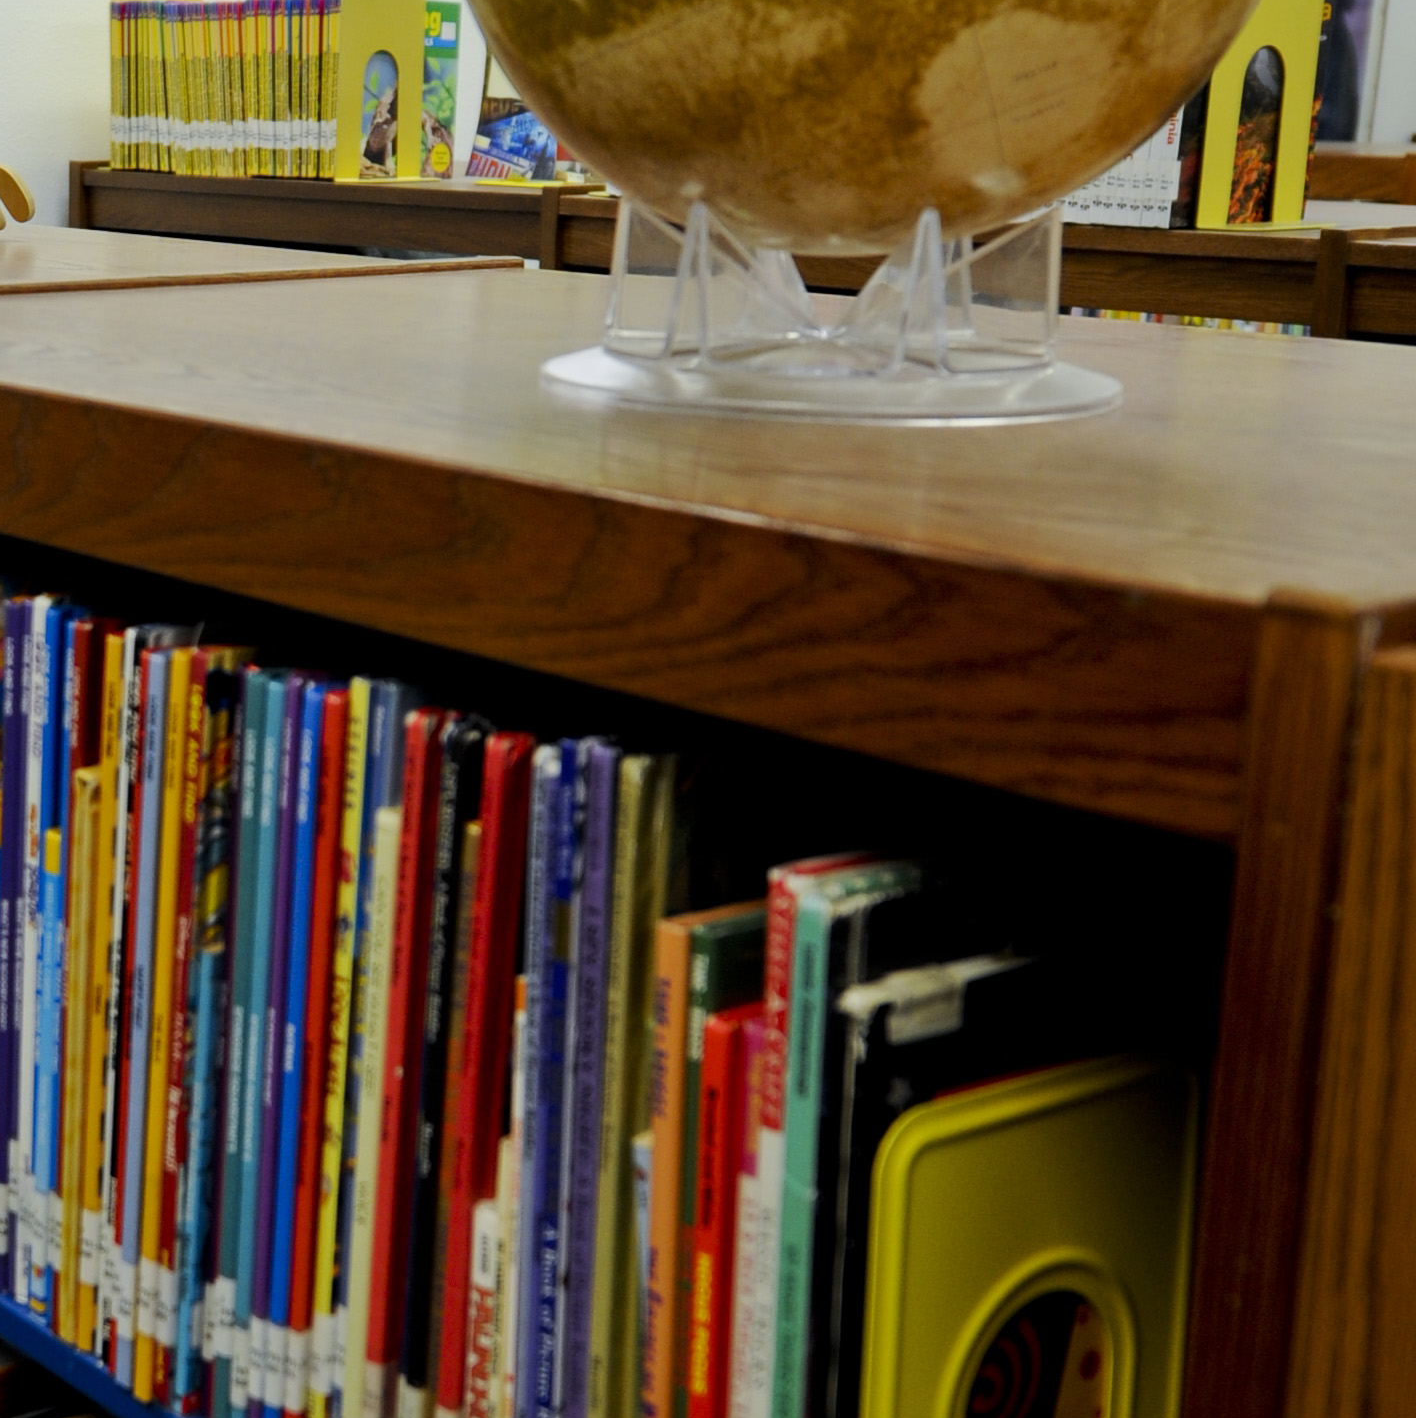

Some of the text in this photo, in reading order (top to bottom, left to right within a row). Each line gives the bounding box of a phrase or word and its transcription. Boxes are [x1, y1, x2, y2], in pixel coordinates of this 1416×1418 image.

[182, 683, 203, 824] LOOK AND FIND
[544, 1224, 559, 1243] A
[542, 1249, 558, 1294] Book
[541, 1302, 556, 1327] of
[538, 1334, 555, 1402] Picture
